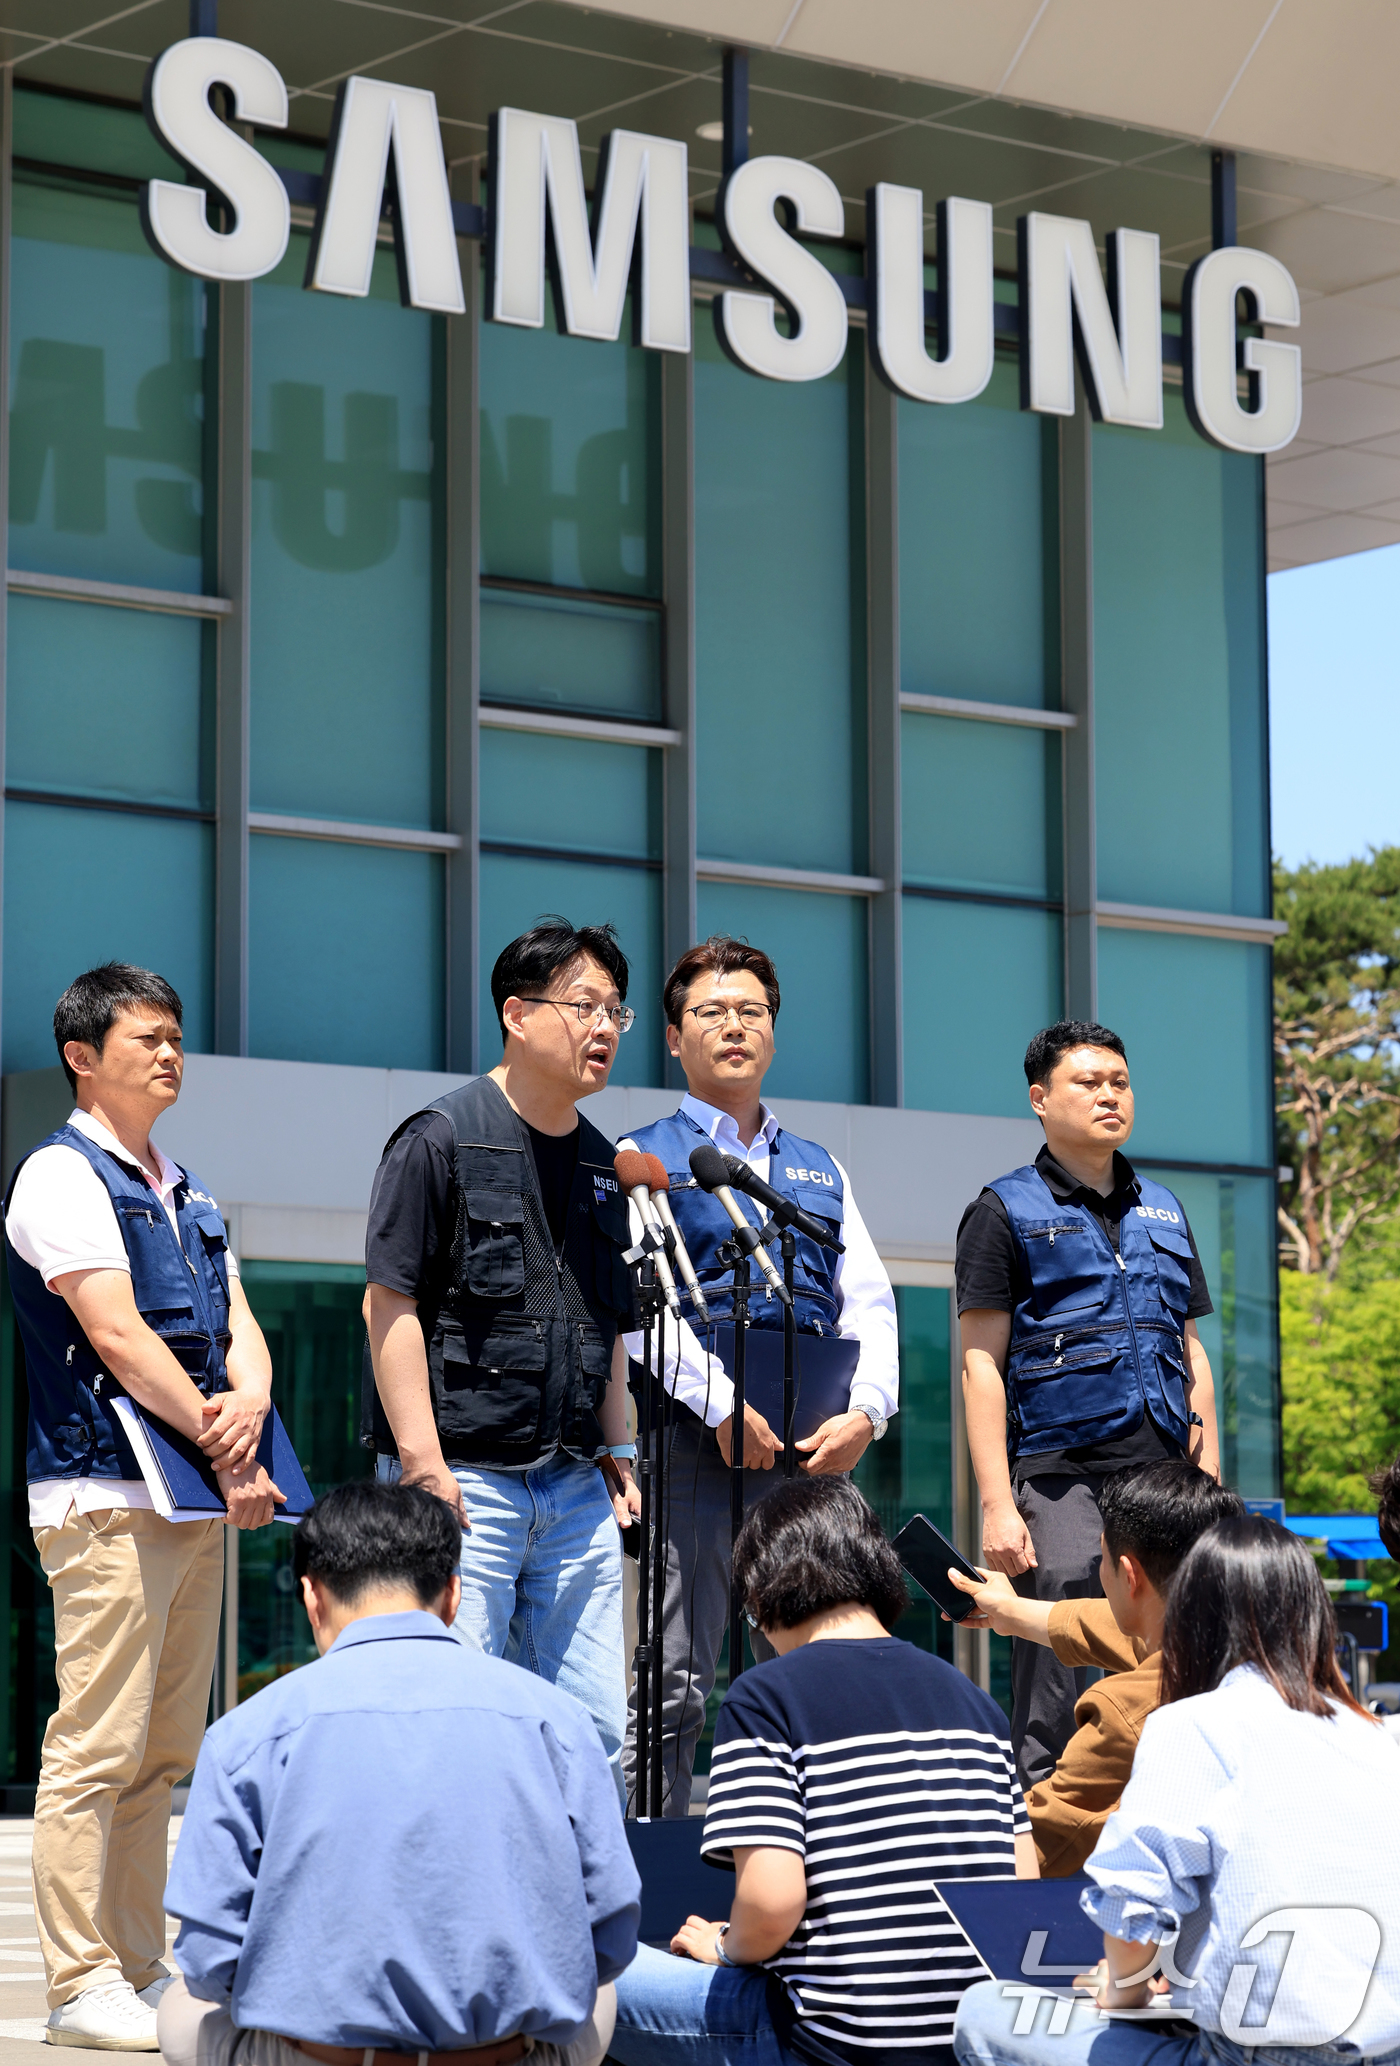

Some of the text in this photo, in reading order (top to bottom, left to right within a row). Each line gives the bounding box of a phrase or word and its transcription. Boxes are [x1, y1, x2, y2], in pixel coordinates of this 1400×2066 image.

[146, 37, 1302, 454] SAMSUNG
[593, 1174, 619, 1193] NSEU
[785, 1166, 834, 1187] SECU
[1135, 1205, 1179, 1223] SECU
